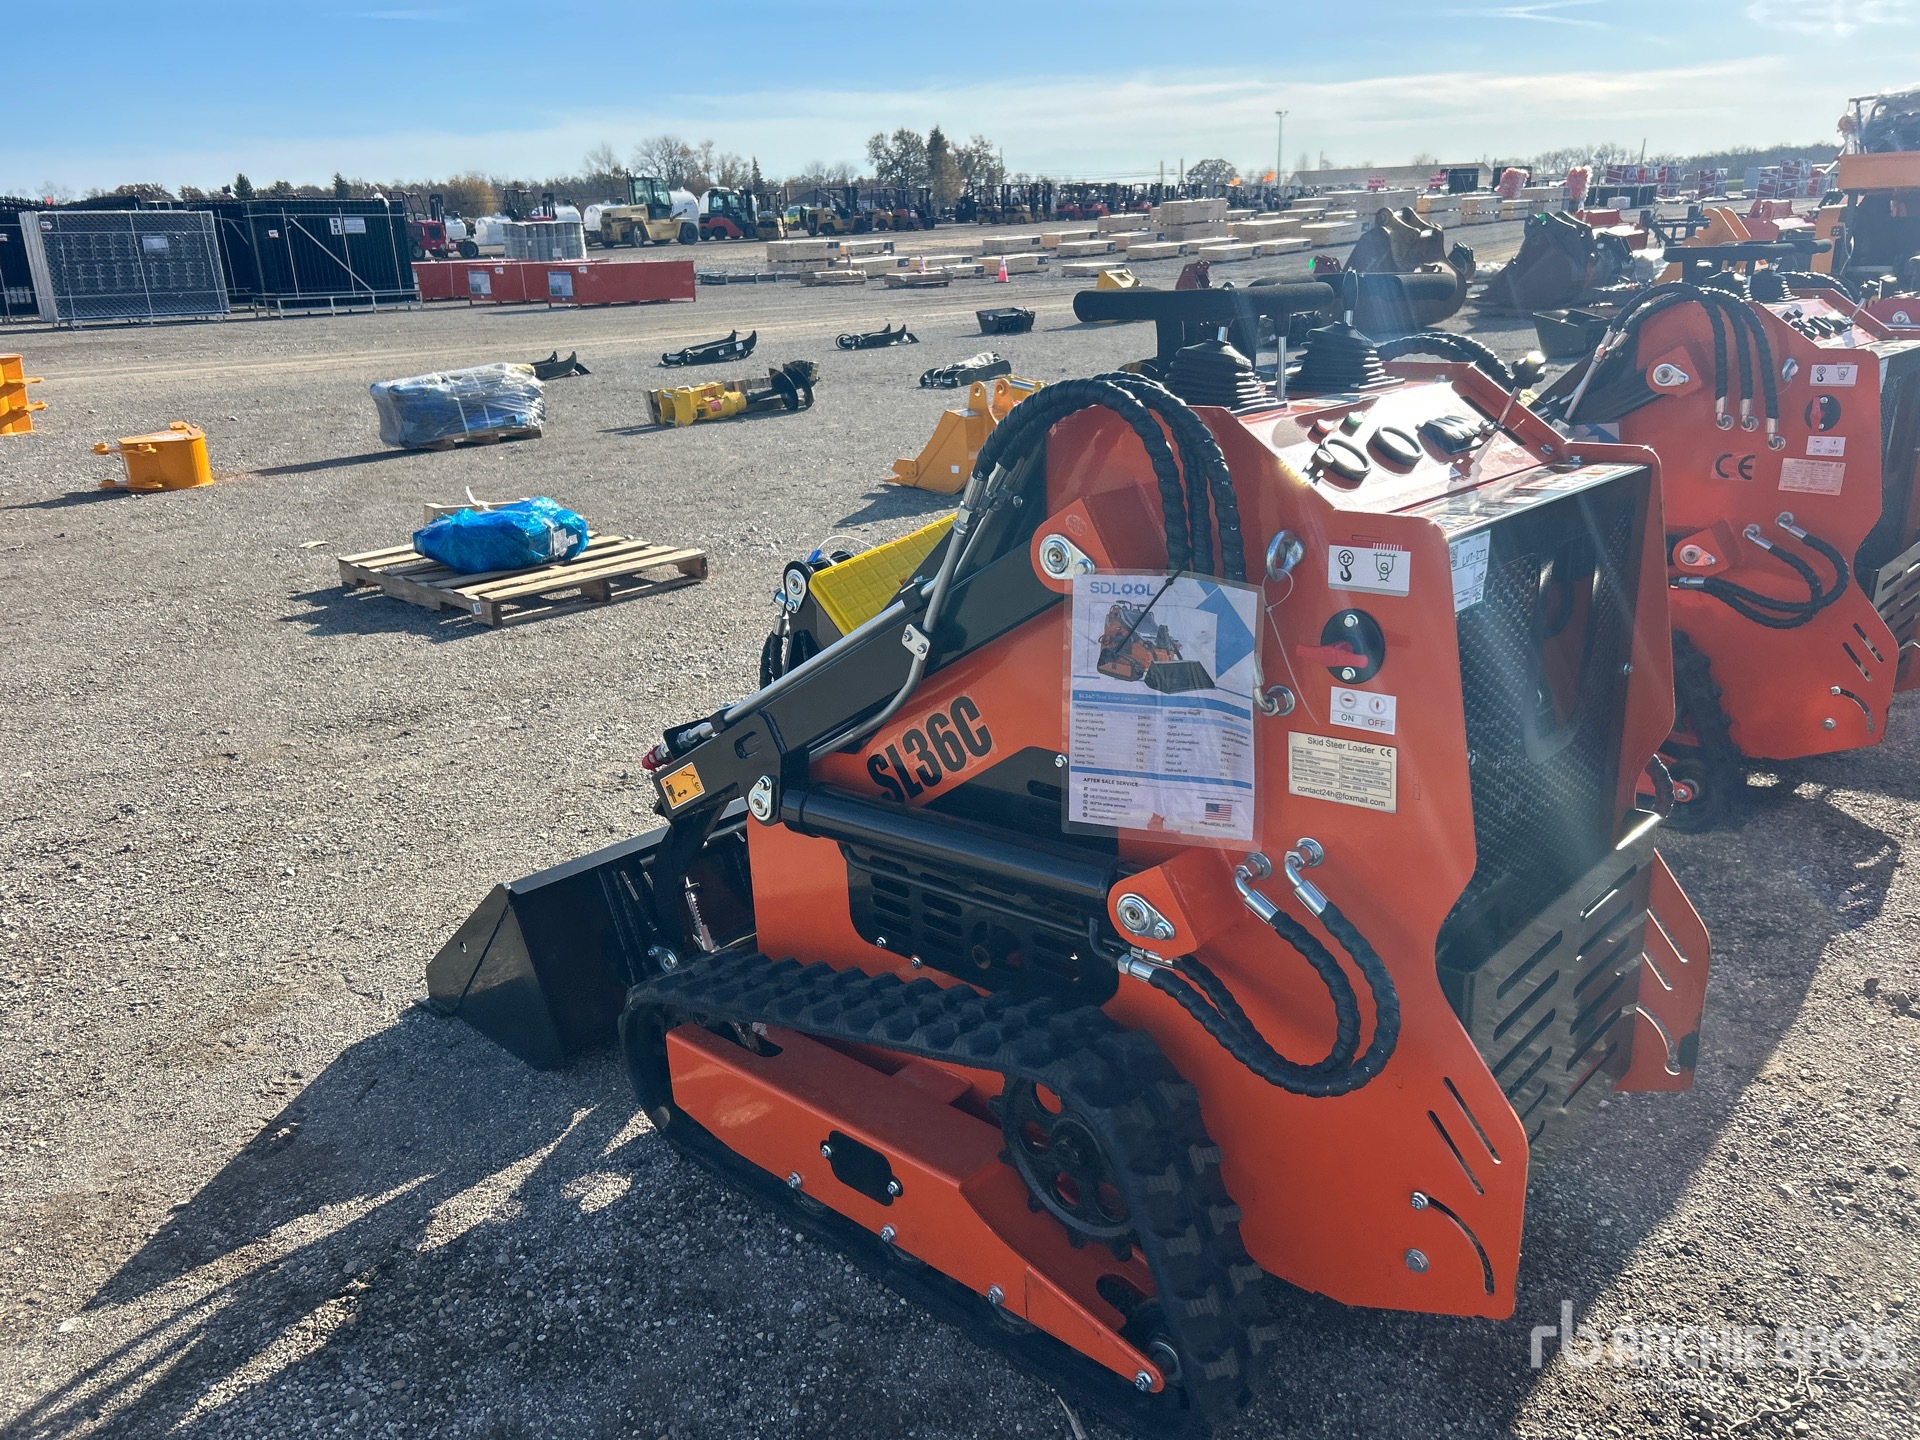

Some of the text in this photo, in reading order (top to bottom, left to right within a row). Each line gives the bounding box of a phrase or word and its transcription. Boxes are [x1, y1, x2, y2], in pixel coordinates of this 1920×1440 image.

[1715, 453, 1756, 481] CE
[1341, 713, 1386, 728] ON OFF
[866, 696, 993, 803] SL36C
[1307, 737, 1375, 754] Skid Steer Loader
[1380, 748, 1392, 758] CE
[1297, 785, 1386, 807] contact24h@foxmail.com
